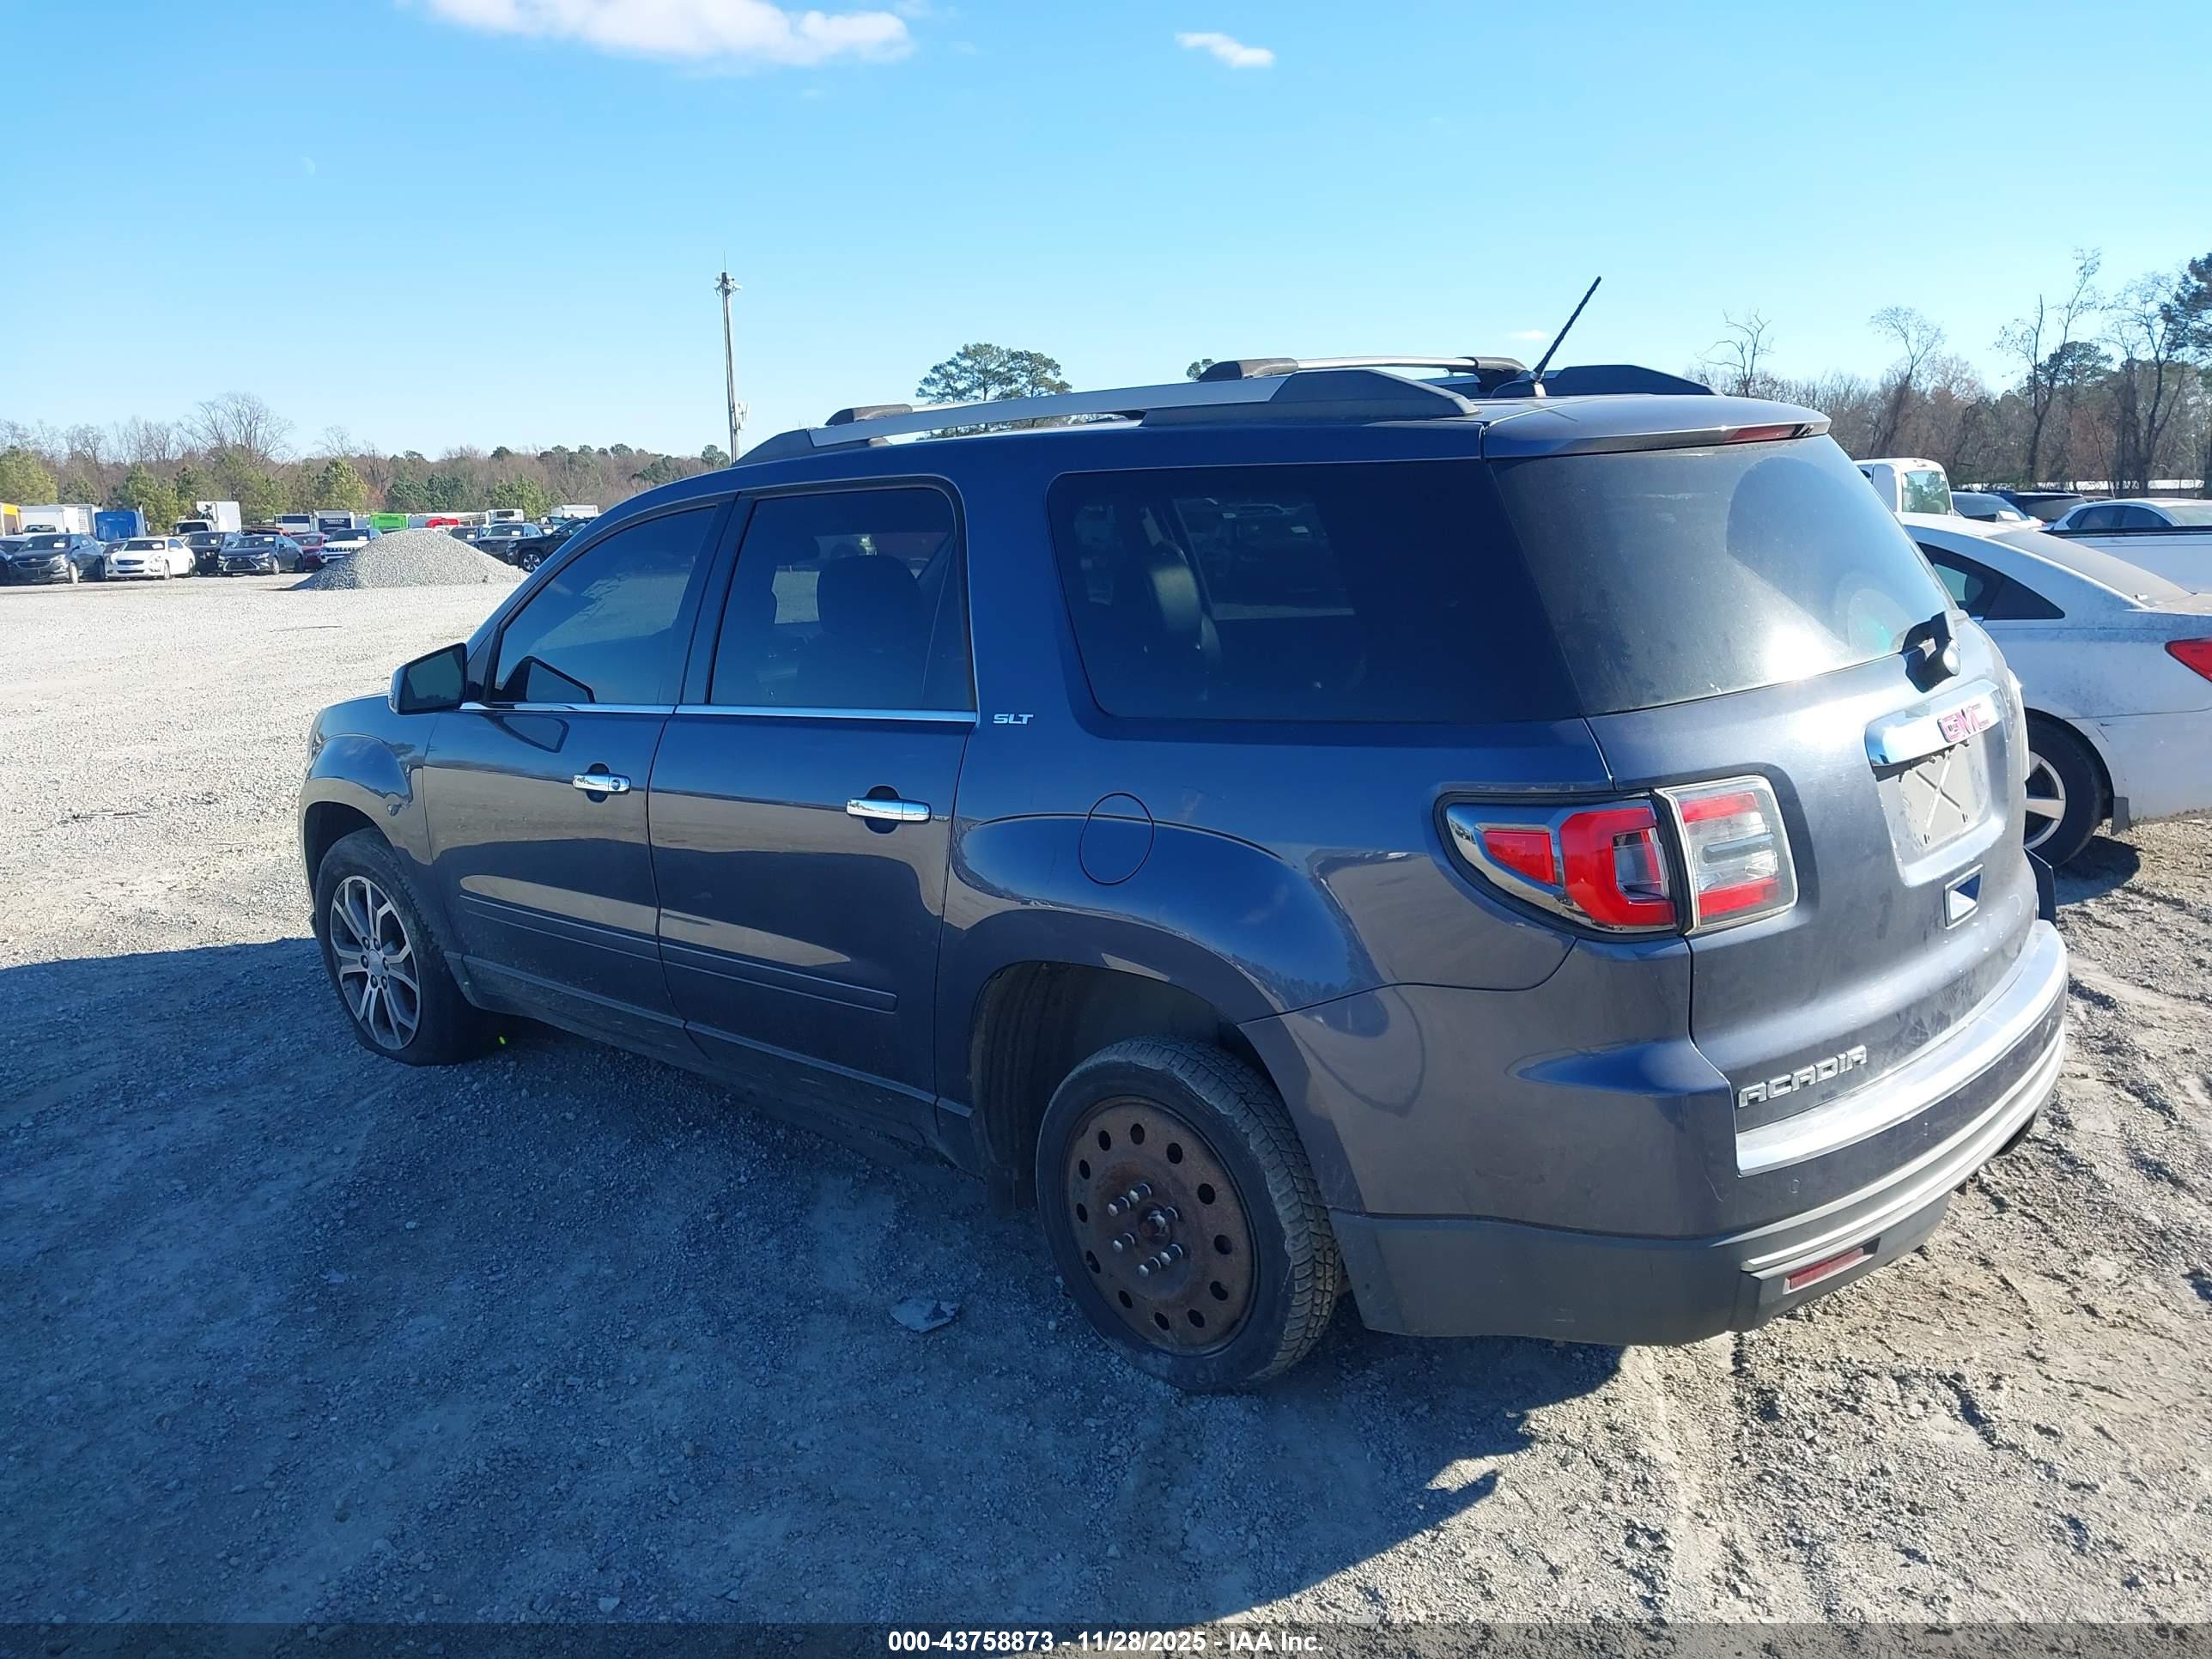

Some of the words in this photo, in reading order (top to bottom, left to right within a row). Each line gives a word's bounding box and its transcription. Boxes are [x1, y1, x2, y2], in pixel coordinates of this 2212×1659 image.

[993, 713, 1034, 725] SLT
[1937, 702, 1990, 743] GMC
[1738, 1044, 1868, 1108] ACADIA
